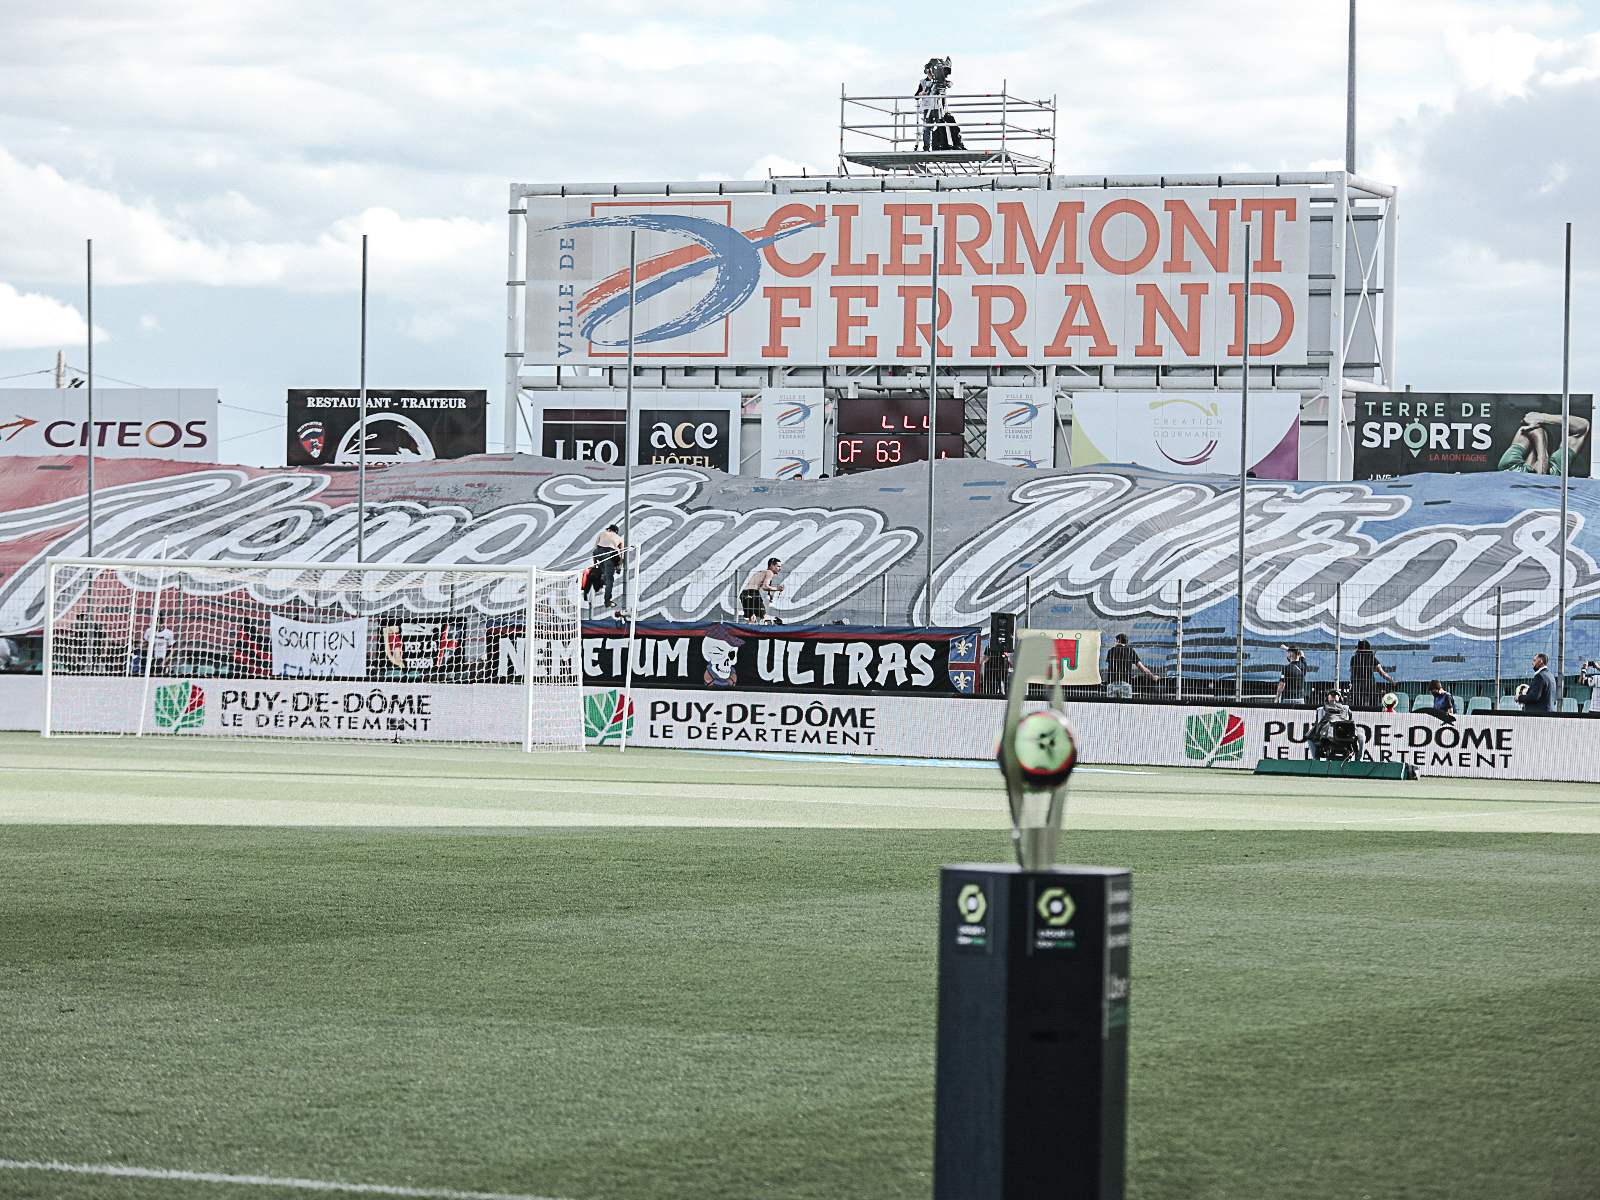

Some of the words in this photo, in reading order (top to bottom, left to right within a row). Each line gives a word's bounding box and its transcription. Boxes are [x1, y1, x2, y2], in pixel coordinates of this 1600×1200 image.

[761, 198, 1297, 278] CLERMONT
[559, 238, 575, 270] DE
[557, 284, 574, 359] VILLE
[761, 282, 1296, 358] FERRAND
[400, 397, 467, 409] TRAITEUR
[1364, 401, 1445, 417] TERRE
[1461, 402, 1491, 418] DE
[44, 420, 208, 448] CITEOS
[1153, 418, 1223, 426] CREATION
[1153, 430, 1222, 438] GOURMANDE
[650, 422, 718, 449] ace
[1361, 419, 1493, 451] SPORTS
[652, 453, 715, 469] HÔTEL
[838, 440, 864, 463] CF
[875, 440, 902, 463] 63
[1429, 453, 1440, 462] LA
[1441, 453, 1487, 462] MONTAGNE
[498, 637, 690, 677] NEMETUM
[757, 638, 936, 687] ULTRAS
[221, 688, 432, 715] PUY-DE-DÔME
[650, 700, 876, 728] PUY-DE-DÔME
[221, 713, 243, 727] LE
[650, 724, 674, 739] LE
[688, 722, 875, 746] DÉPARTEMENT
[1263, 745, 1290, 760] LE
